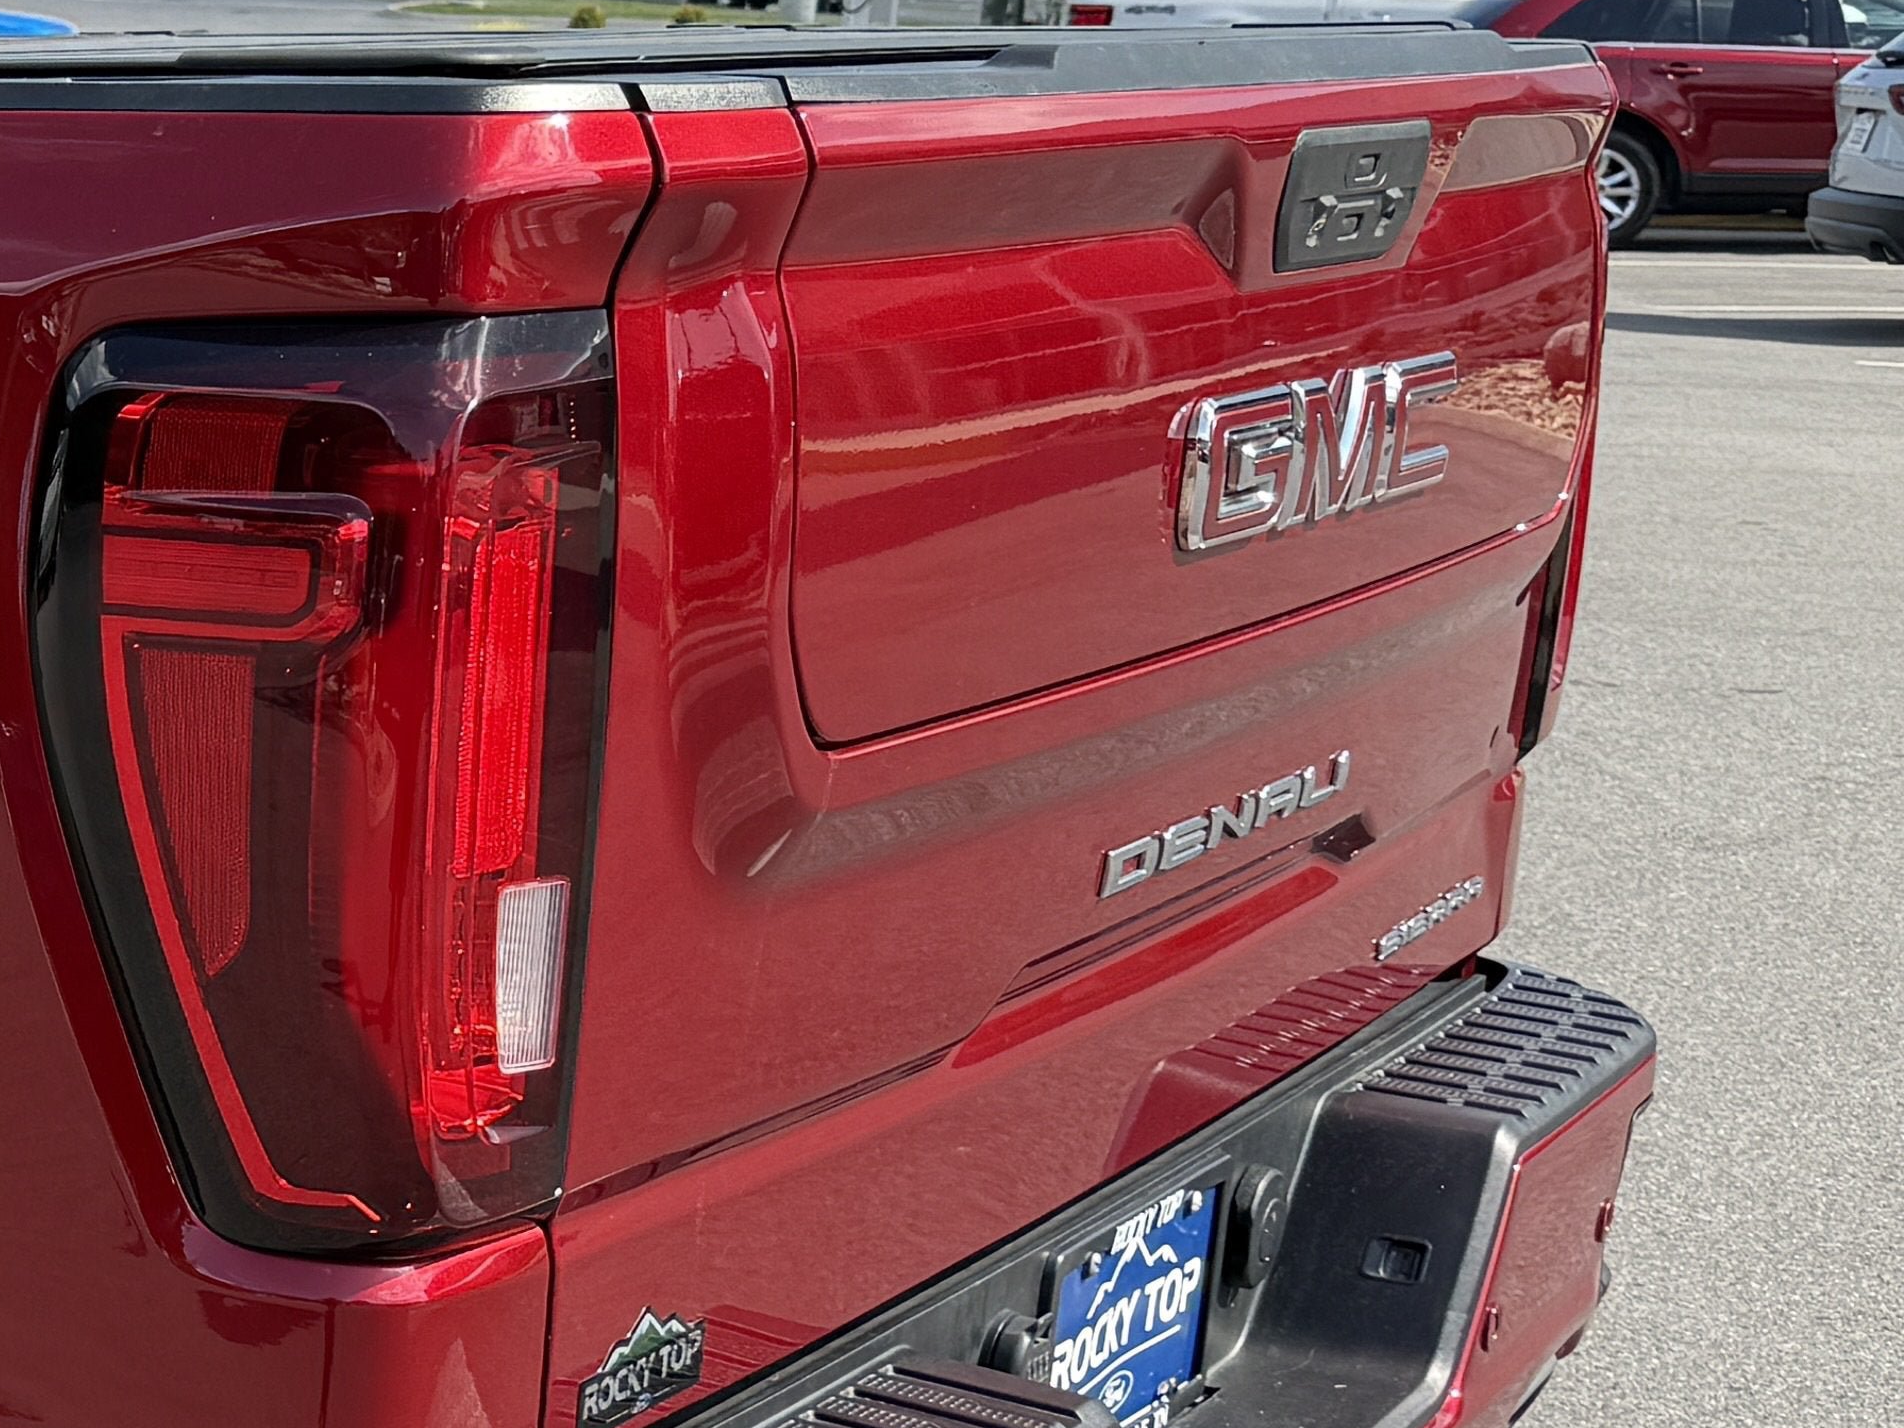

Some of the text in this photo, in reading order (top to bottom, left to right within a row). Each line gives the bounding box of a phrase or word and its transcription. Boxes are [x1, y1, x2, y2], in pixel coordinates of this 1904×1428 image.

[1176, 350, 1458, 552] GMC
[1097, 749, 1351, 899] DENALI
[1156, 1188, 1184, 1229] TOP
[582, 1329, 703, 1420] ROCKY TOP
[1049, 1256, 1202, 1391] ROCKY TOP
